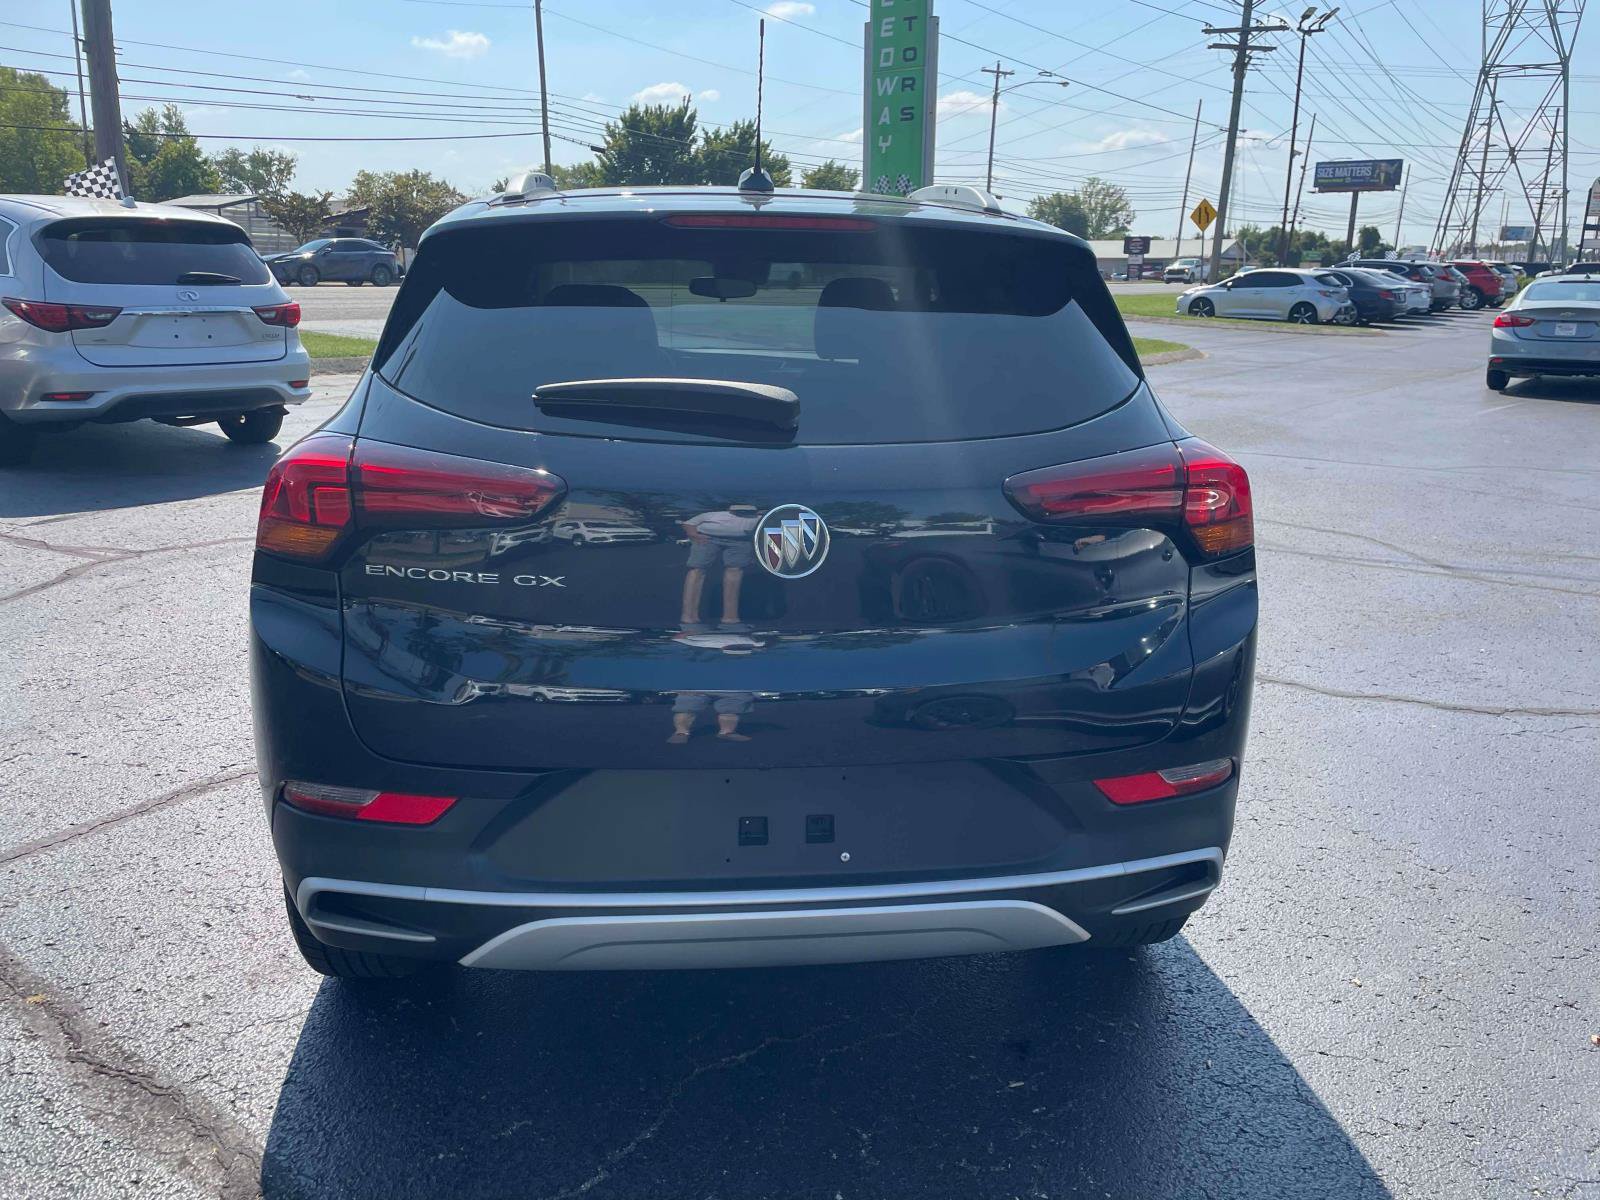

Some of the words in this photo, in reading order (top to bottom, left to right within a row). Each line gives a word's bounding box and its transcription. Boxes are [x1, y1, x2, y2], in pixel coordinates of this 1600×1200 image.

[899, 0, 918, 122] TORS
[1317, 167, 1334, 177] SIZE
[1335, 166, 1372, 177] MATTERS
[364, 564, 500, 584] ENCORE
[513, 574, 567, 588] GX
